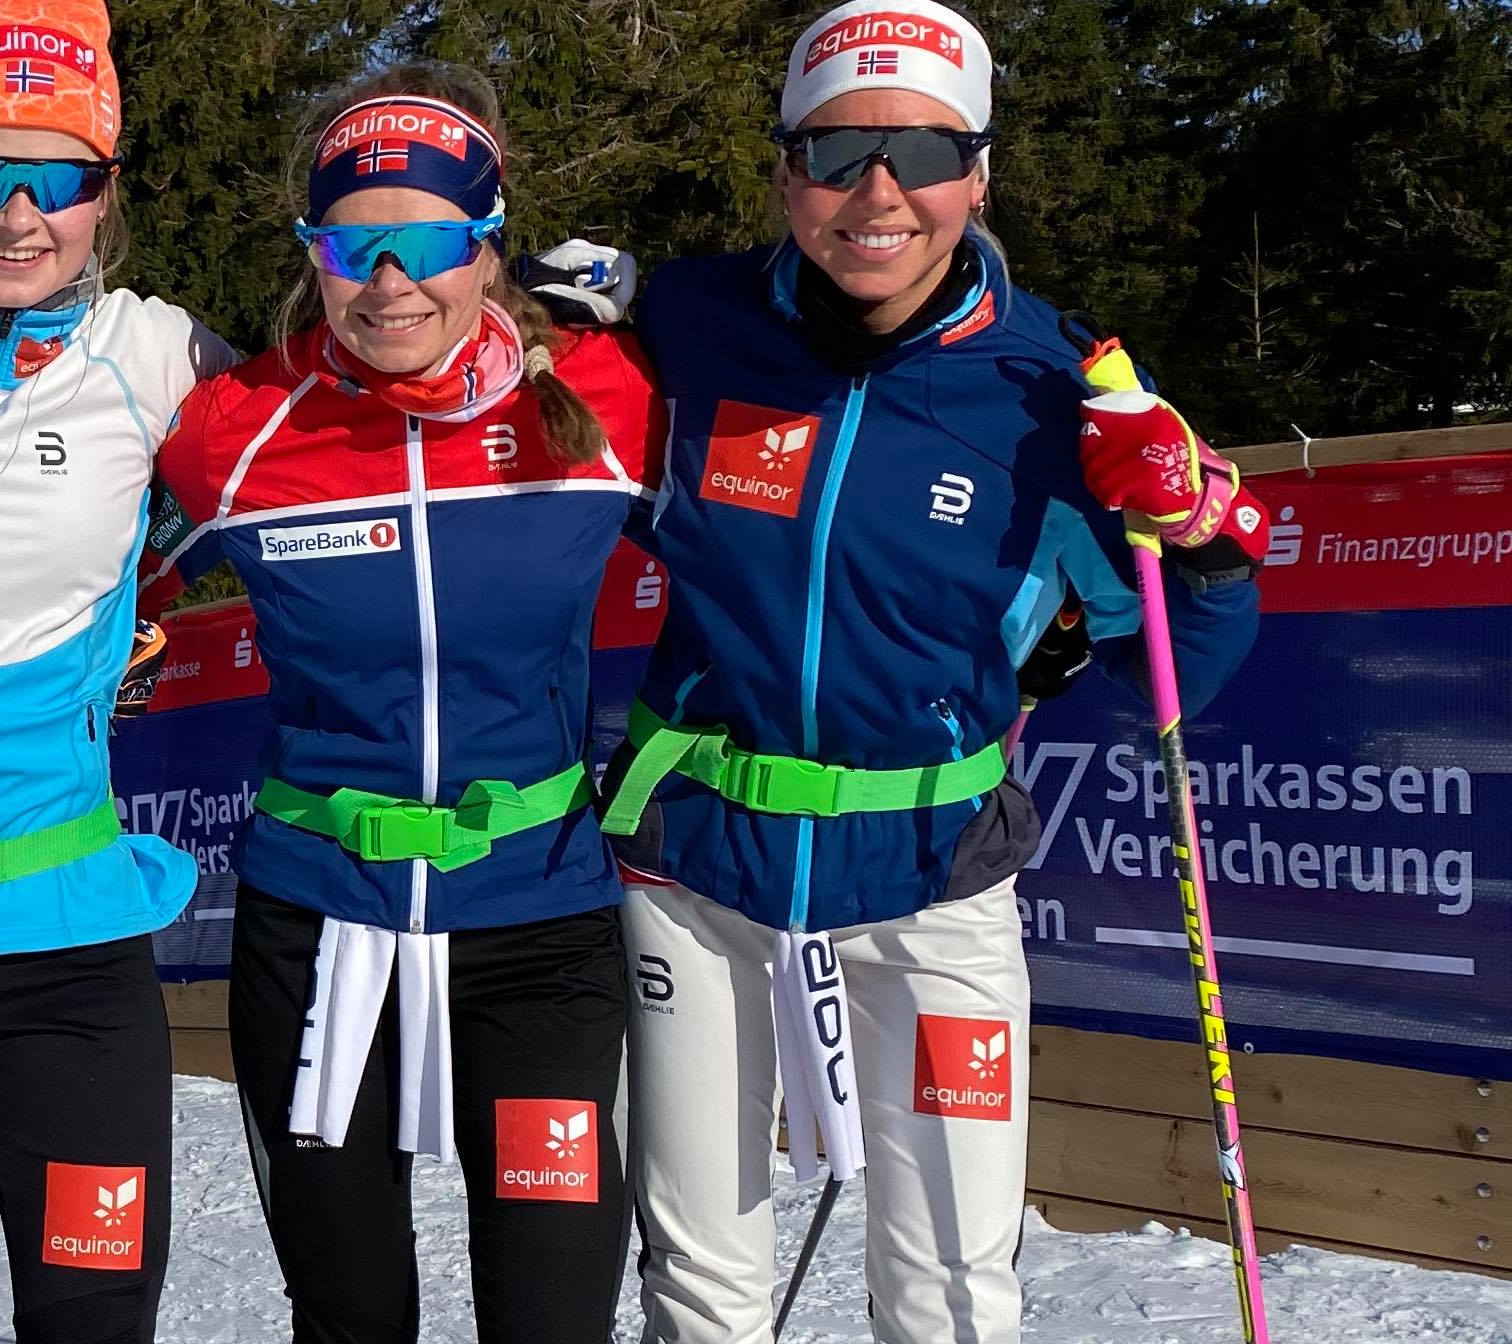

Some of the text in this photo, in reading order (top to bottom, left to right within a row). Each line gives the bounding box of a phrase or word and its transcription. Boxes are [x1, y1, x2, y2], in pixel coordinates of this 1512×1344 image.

[807, 16, 934, 61] equinor
[322, 110, 436, 157] equinor
[711, 471, 794, 501] equinor
[265, 529, 367, 557] SpareBank
[1105, 743, 1473, 819] Sparkassen
[1075, 818, 1474, 915] Vericherung
[1199, 979, 1236, 1105] LEKI
[922, 1084, 1005, 1108] equinor
[503, 1165, 589, 1191] equinor
[50, 1235, 135, 1257] equinor
